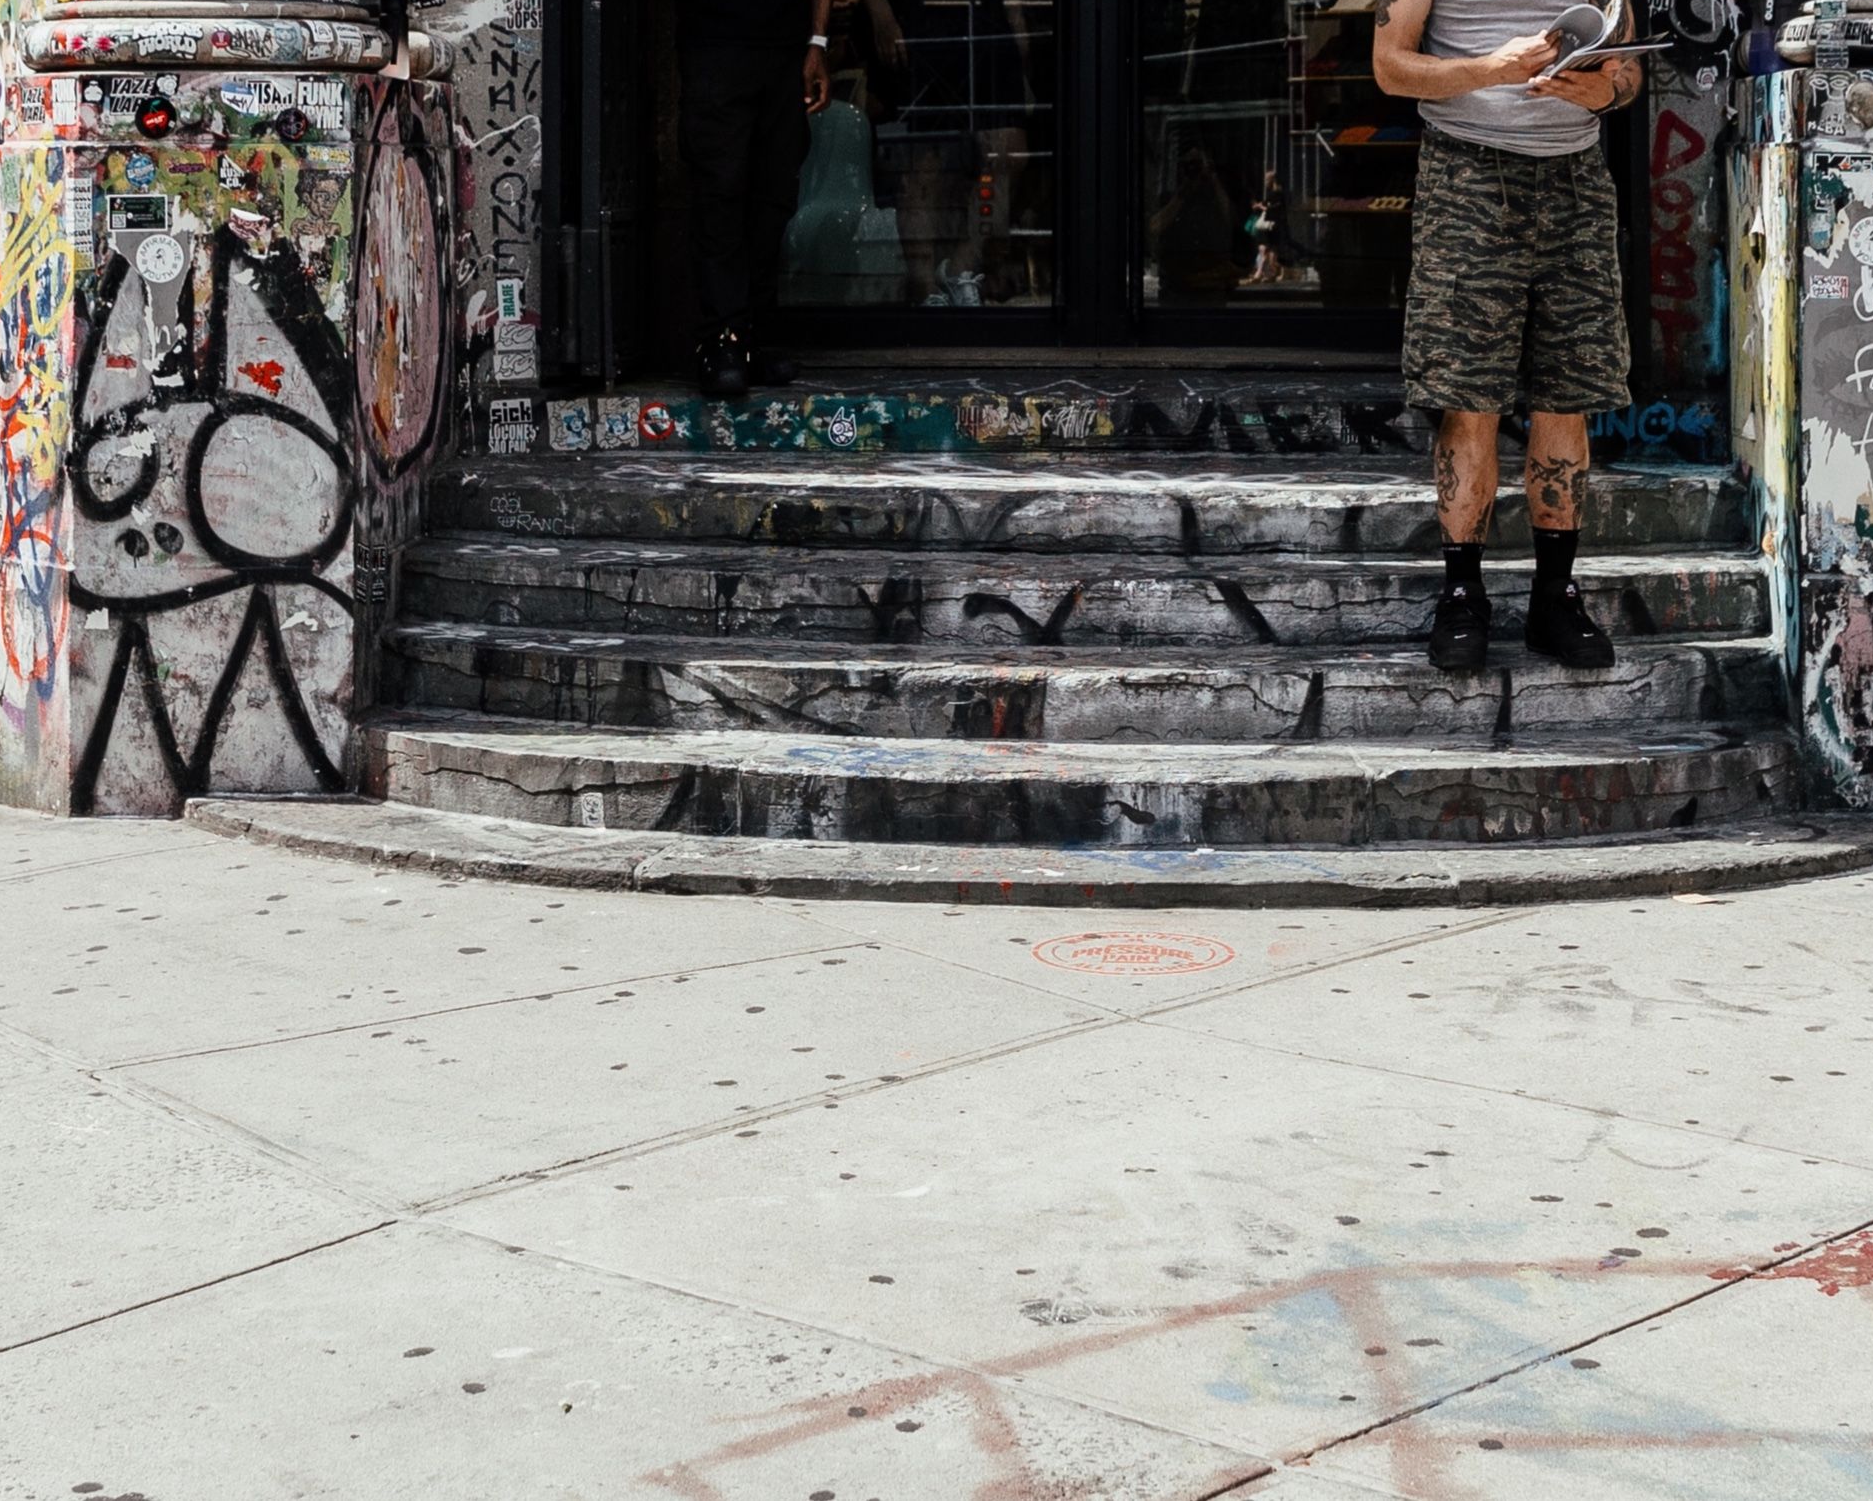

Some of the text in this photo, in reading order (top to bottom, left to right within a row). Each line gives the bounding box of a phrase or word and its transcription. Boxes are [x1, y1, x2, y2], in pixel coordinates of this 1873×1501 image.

[138, 36, 201, 57] WORLD
[110, 77, 156, 96] YAZE
[297, 81, 344, 105] FUNK
[139, 234, 182, 262] AFFIRMATIVE
[145, 265, 176, 282] YOUTH
[492, 402, 533, 424] sick
[517, 513, 576, 536] RANCH
